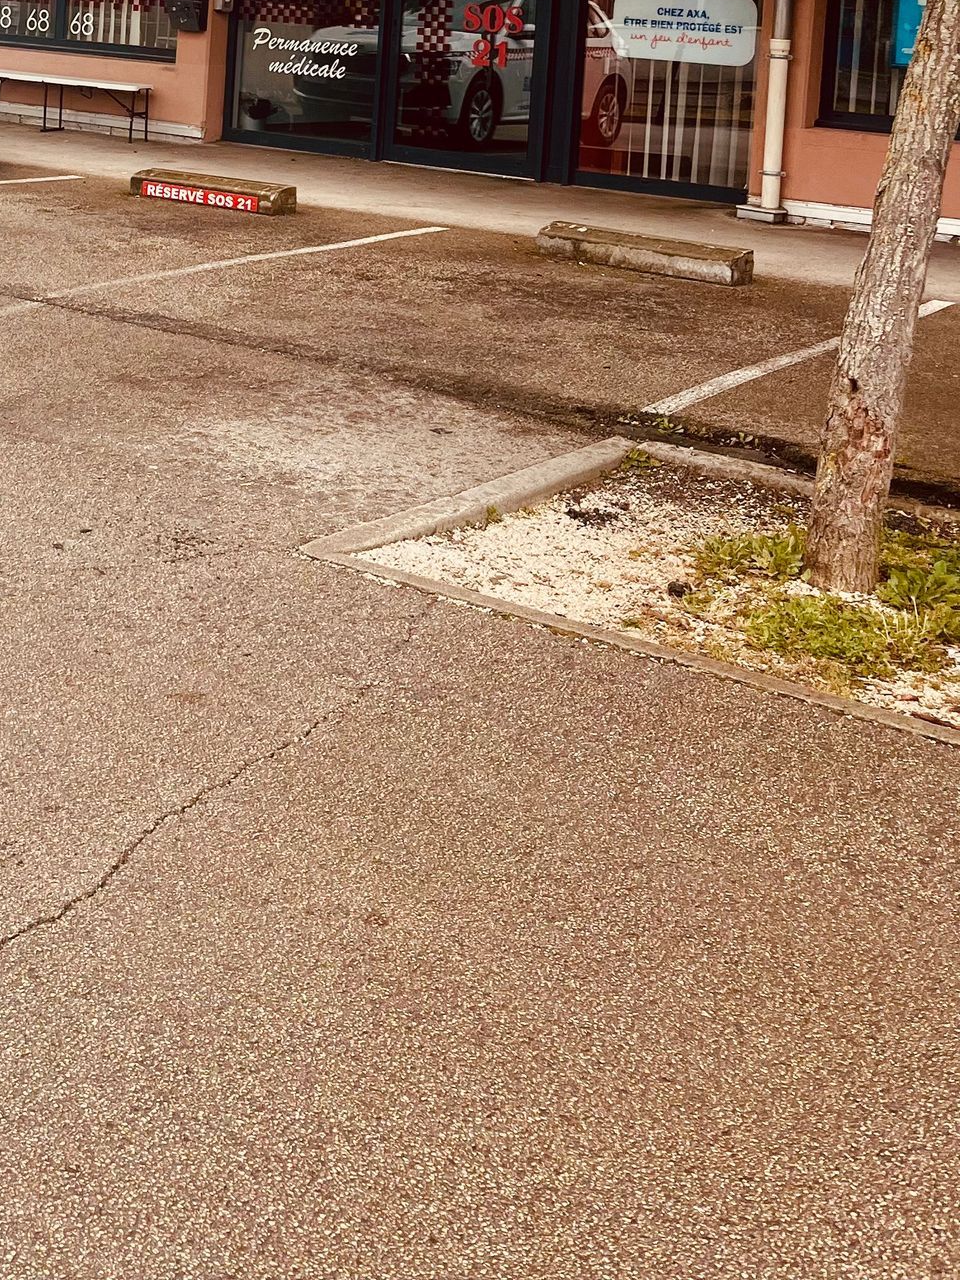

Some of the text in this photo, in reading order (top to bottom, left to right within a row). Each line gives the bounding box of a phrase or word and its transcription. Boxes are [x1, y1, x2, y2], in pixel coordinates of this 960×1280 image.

[26, 8, 50, 32] 68
[70, 12, 94, 36] 68
[463, 3, 525, 34] SOS
[624, 15, 744, 35] ÊTRE BIEN PROTÉGÉ EST
[657, 7, 684, 18] CHEZ
[252, 27, 358, 57] Permanence
[471, 39, 508, 68] 21
[630, 32, 732, 50] un jeu d'enfant
[268, 57, 346, 80] médicale
[147, 183, 252, 210] RÉSERVÉ SOS 21
